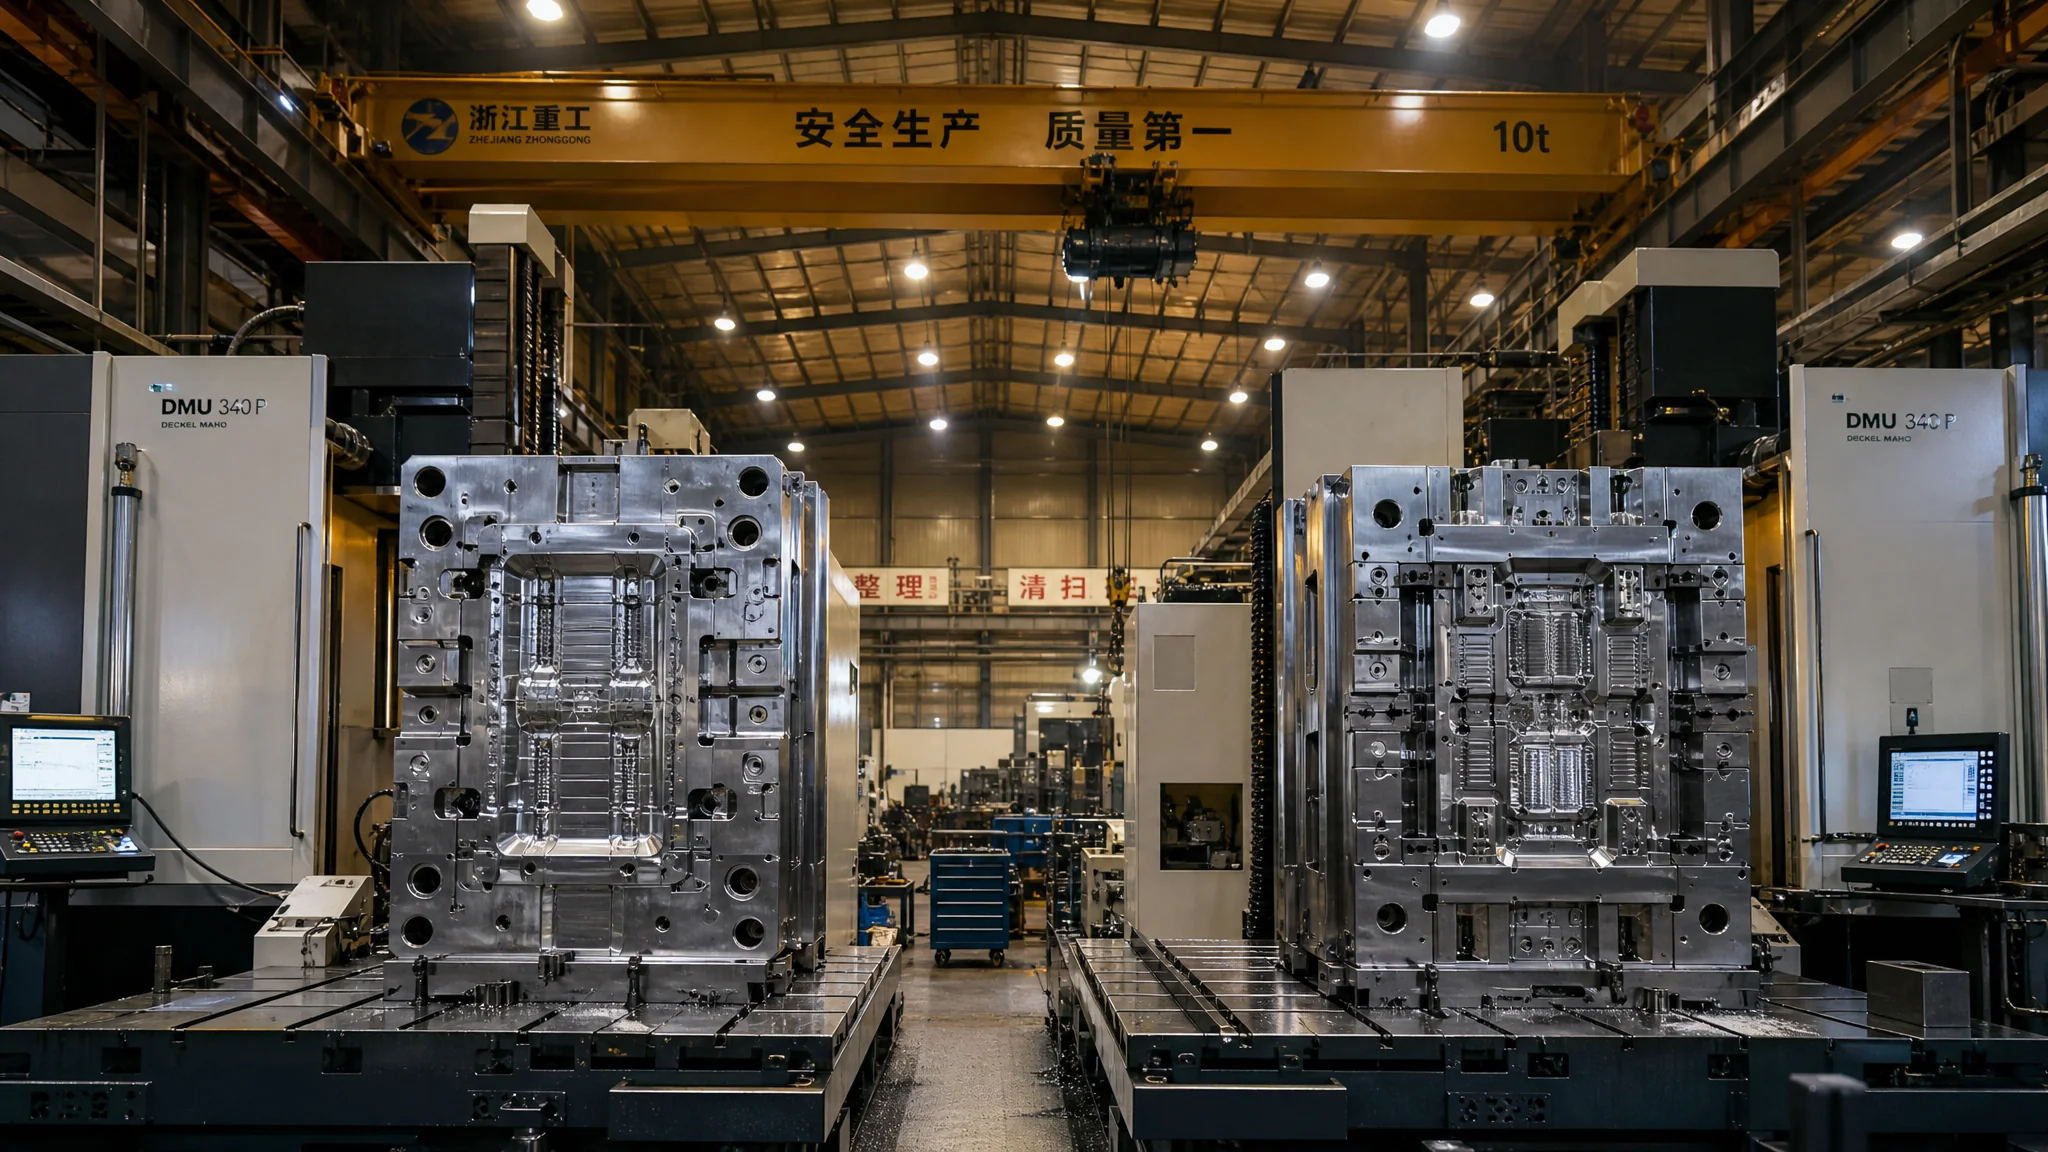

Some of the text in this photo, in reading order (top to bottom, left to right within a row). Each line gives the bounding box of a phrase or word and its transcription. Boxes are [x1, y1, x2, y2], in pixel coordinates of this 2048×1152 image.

[469, 105, 591, 131] 浙江重工
[469, 135, 591, 144] ZHEJIANG ZHONGGONG
[795, 107, 1232, 152] 安全生产 质量第一
[1493, 120, 1550, 153] 10t
[161, 398, 268, 416] DMU 340 P
[161, 421, 227, 429] DECKEL MAHO
[1846, 412, 1957, 430] DMU 340 P
[855, 573, 923, 599] 整理
